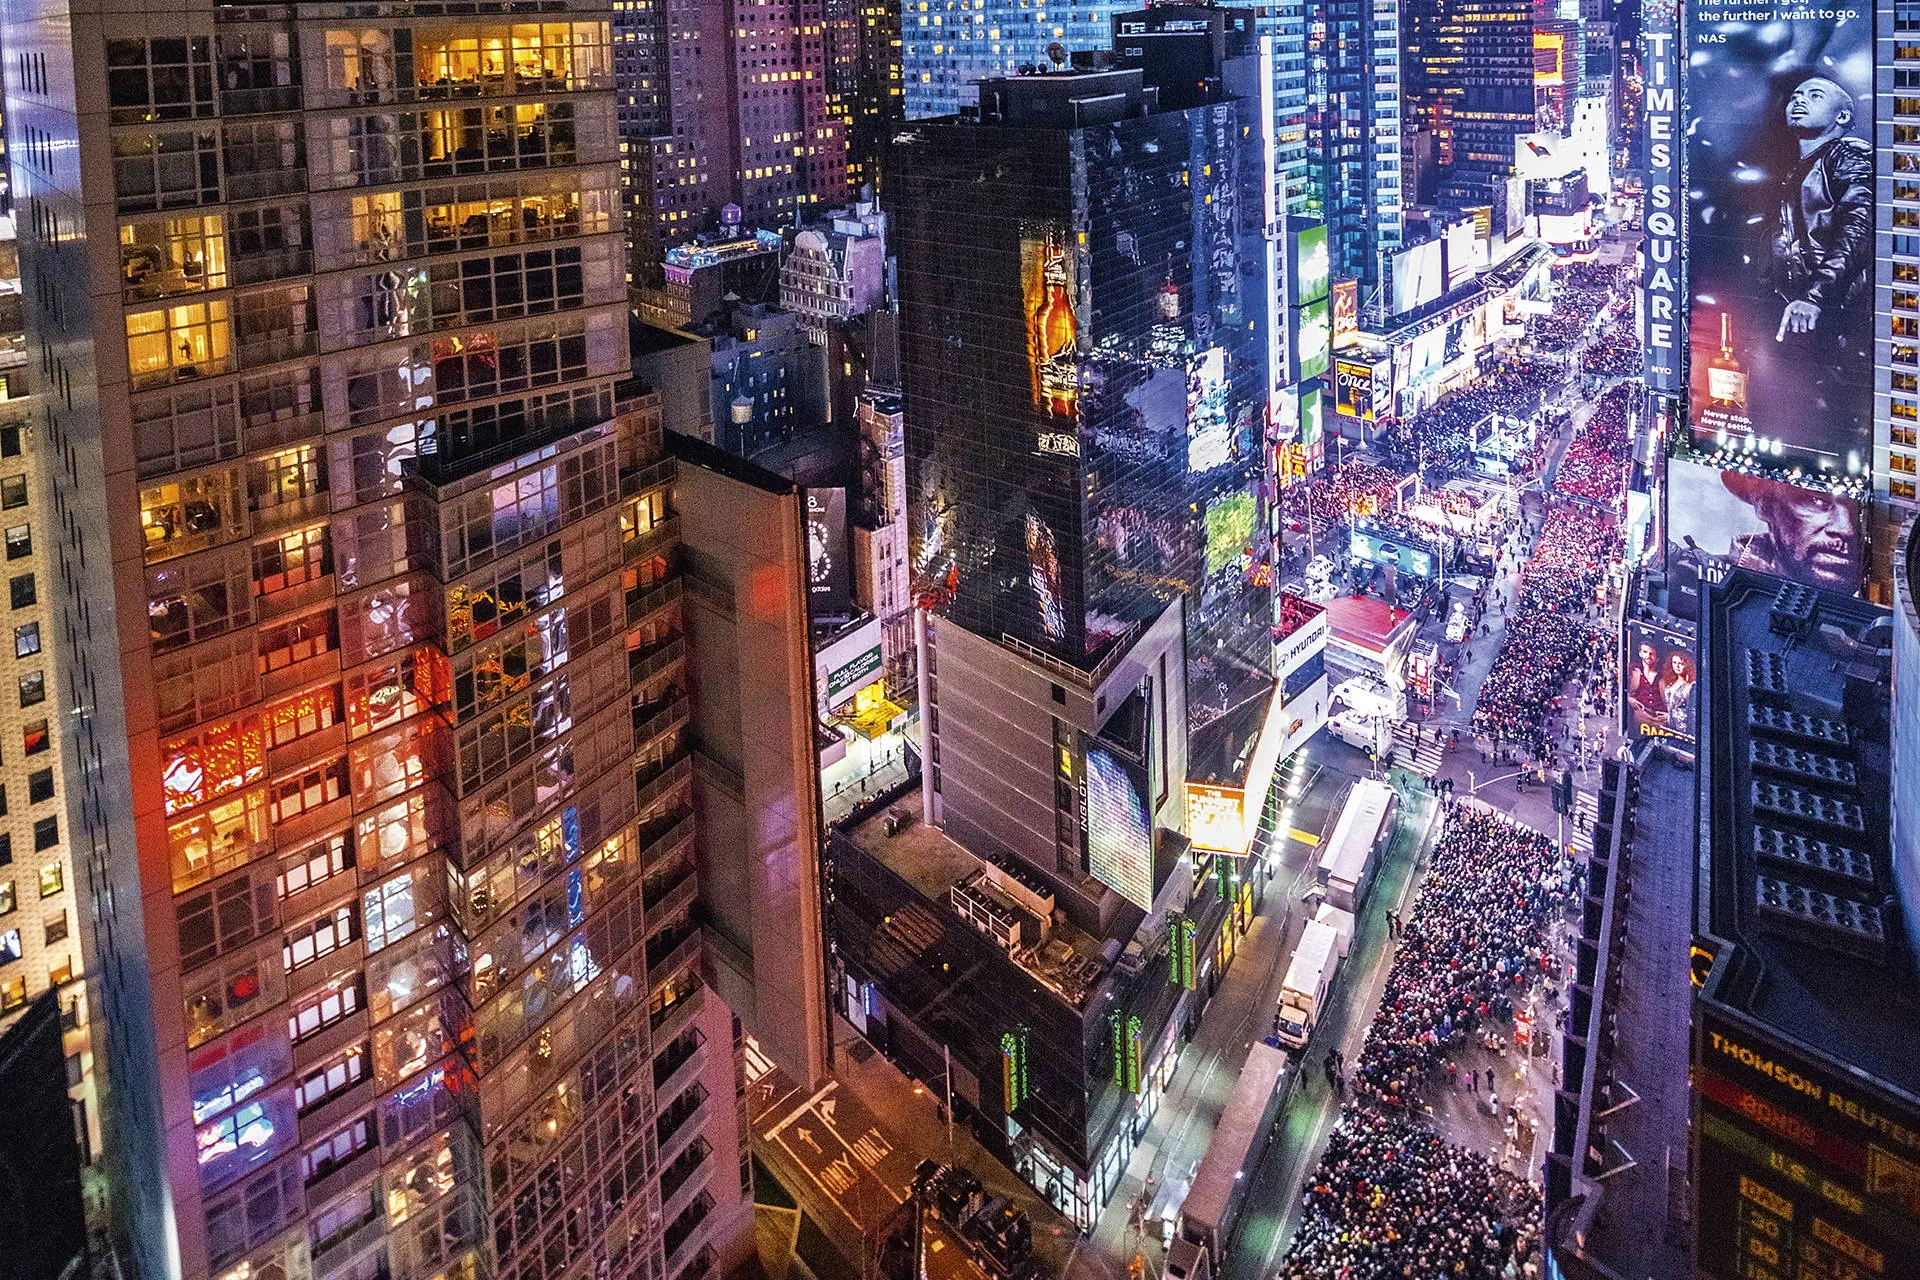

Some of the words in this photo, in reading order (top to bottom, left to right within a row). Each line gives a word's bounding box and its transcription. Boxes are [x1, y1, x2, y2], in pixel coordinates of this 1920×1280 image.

[1698, 11, 1720, 21] the
[1723, 11, 1770, 21] further
[1773, 10, 1777, 20] I
[1780, 9, 1816, 20] want
[1819, 8, 1835, 19] to
[1836, 10, 1860, 22] go.
[1698, 34, 1727, 44] NAS
[1646, 33, 1675, 168] TIMES
[1647, 185, 1676, 348] SQUARE
[1651, 365, 1672, 375] NYC
[1701, 417, 1726, 427] Never
[1728, 422, 1754, 433] settle.
[1704, 409, 1729, 420] Never
[1730, 415, 1753, 425] stop.
[1290, 625, 1325, 659] HYUNDAI
[828, 675, 845, 689] ONLY
[833, 668, 849, 681] FULL
[839, 677, 852, 688] GET
[852, 666, 869, 680] BOTH
[1079, 776, 1088, 833] INGLOT
[1710, 1032, 1823, 1100] THOMSON
[853, 1127, 893, 1167] ONLY
[820, 1153, 860, 1195] ONLY
